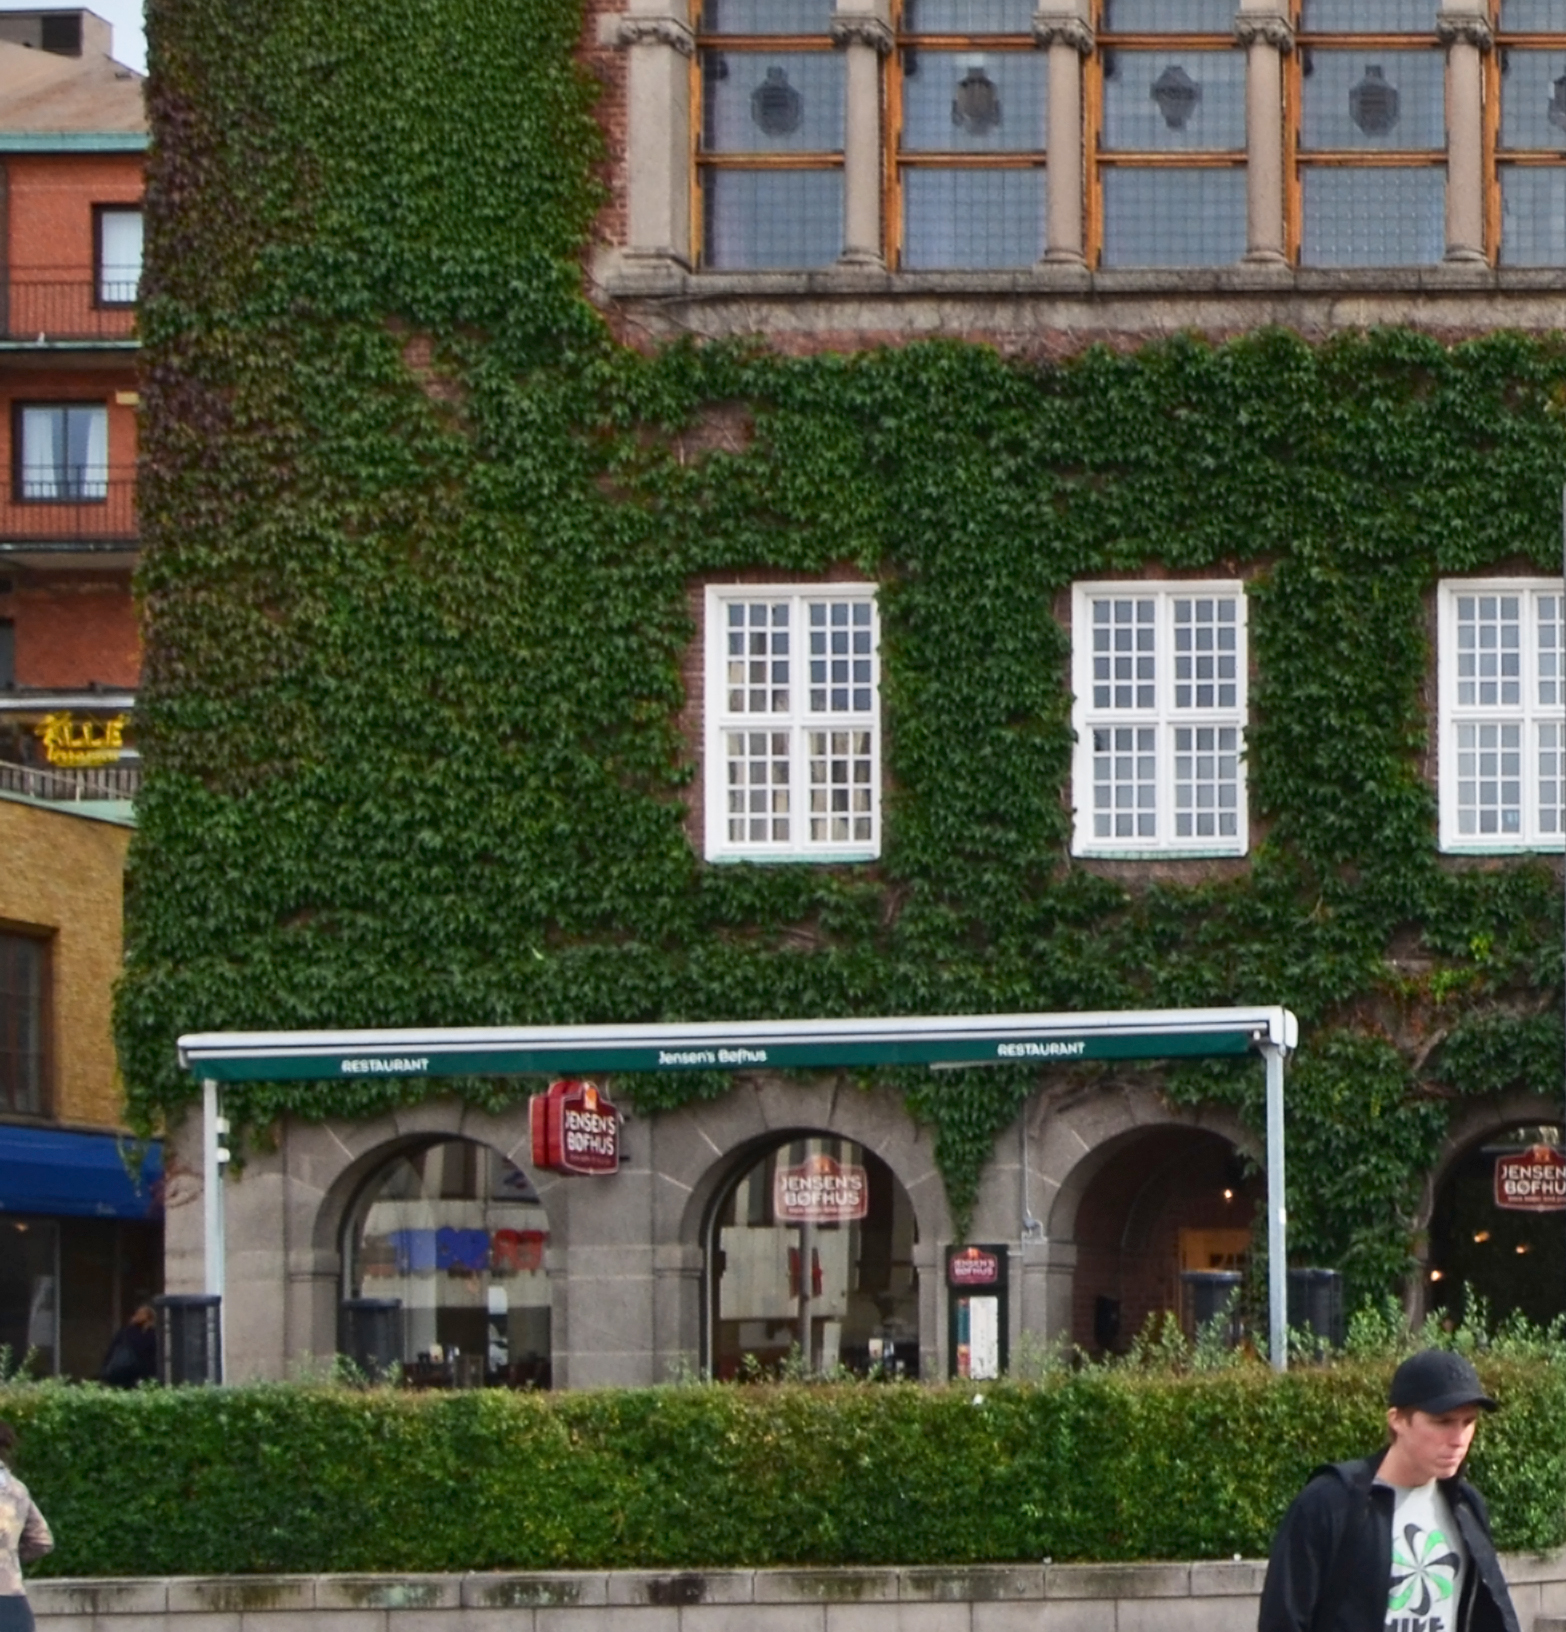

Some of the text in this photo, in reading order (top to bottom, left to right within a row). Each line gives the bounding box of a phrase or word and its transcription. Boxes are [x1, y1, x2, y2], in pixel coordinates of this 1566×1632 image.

[998, 1042, 1085, 1057] RESTAURANT
[341, 1057, 429, 1073] RESTAURANT
[659, 1050, 715, 1065] Jensen's
[565, 1109, 616, 1135] JENSEN'S
[1501, 1164, 1566, 1180] JENSEN
[781, 1175, 863, 1190] JENSEN'S
[1505, 1180, 1566, 1195] BØFHU
